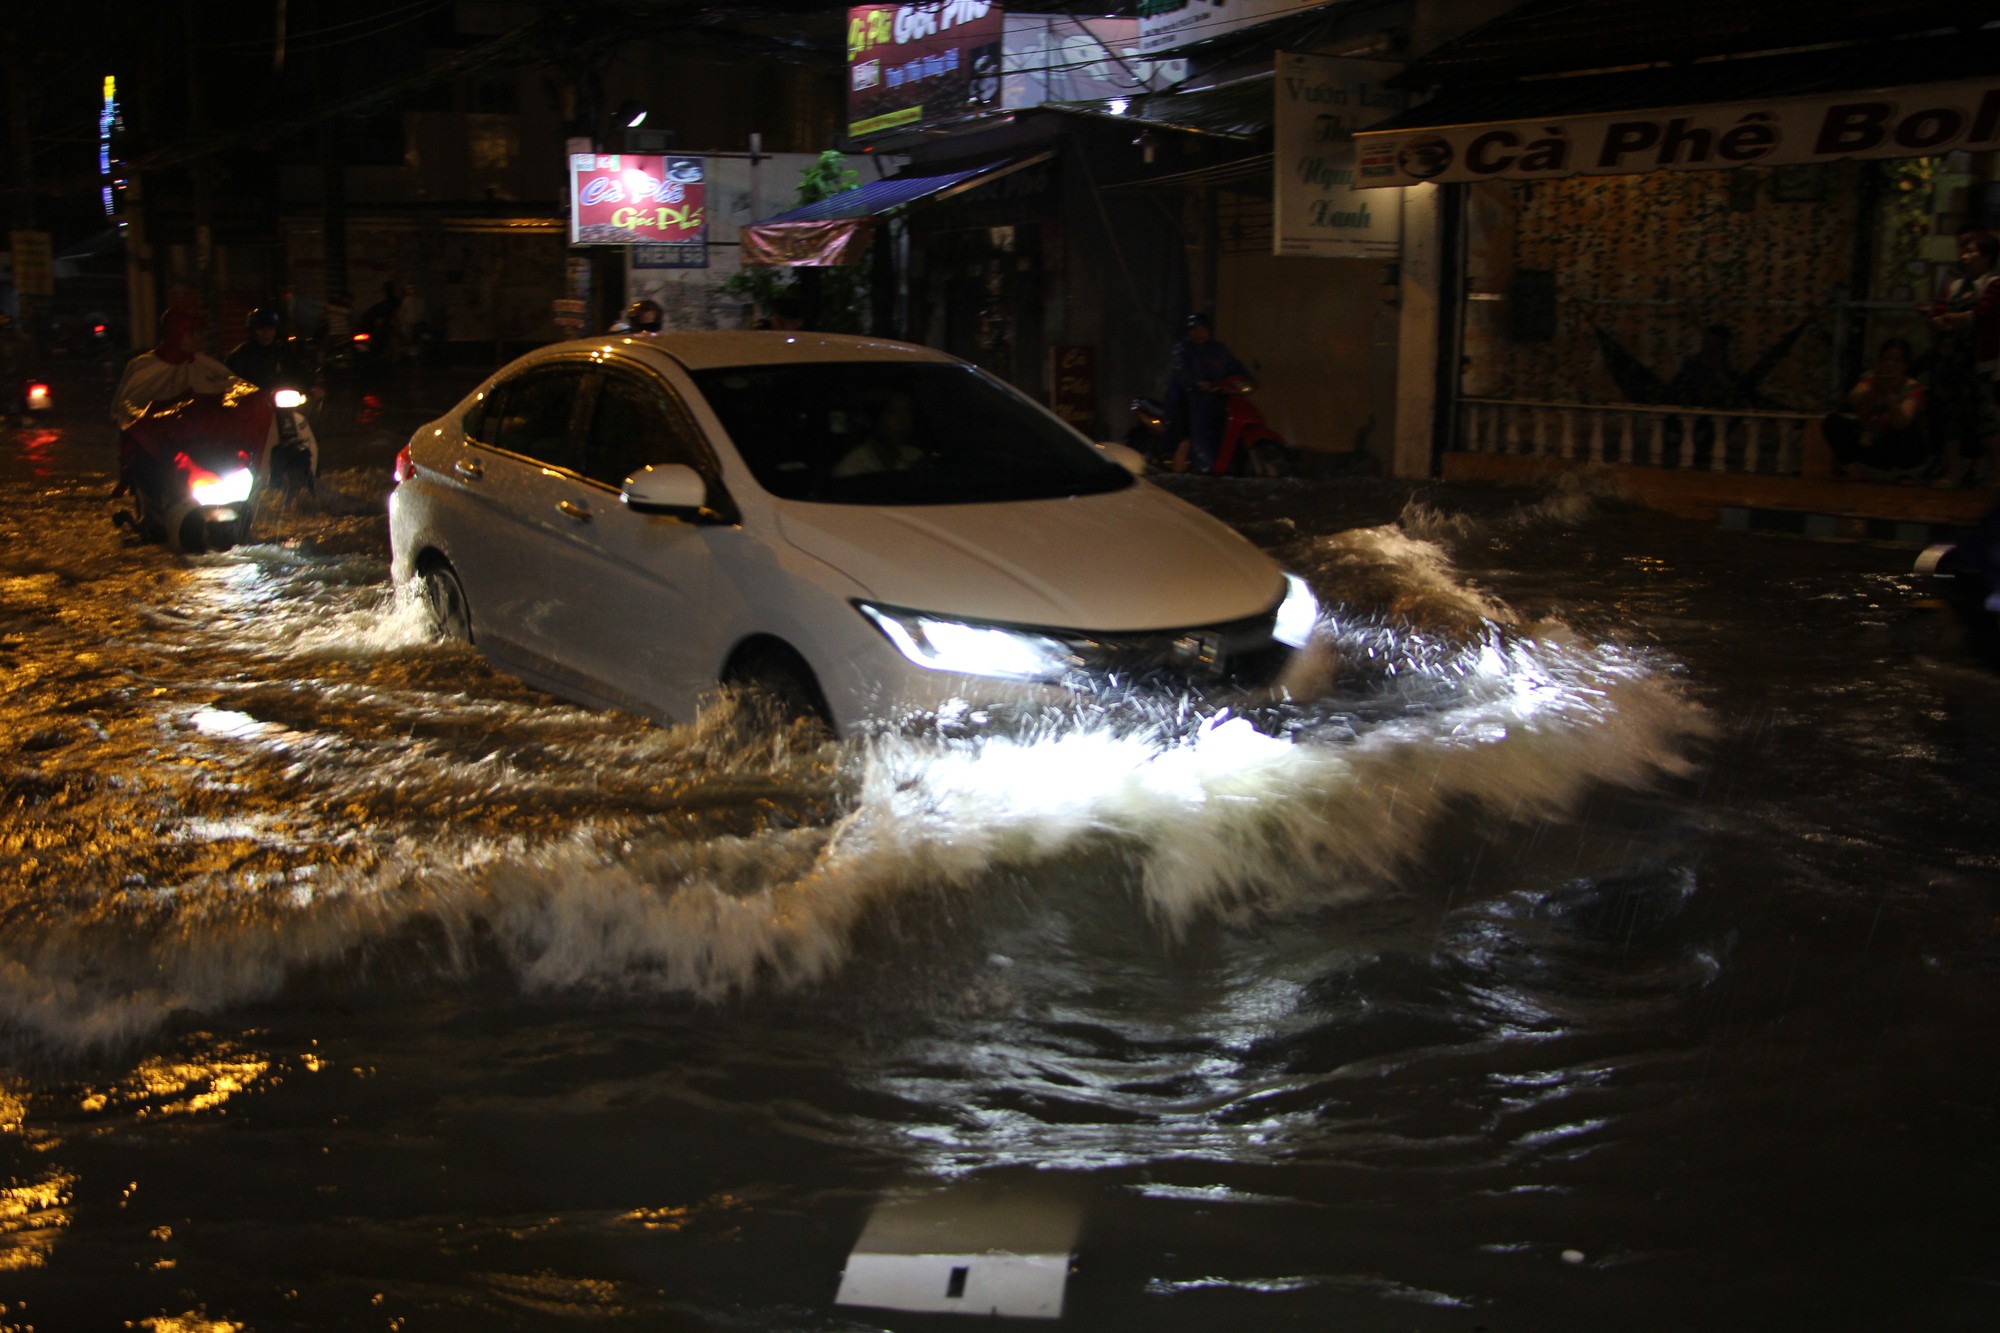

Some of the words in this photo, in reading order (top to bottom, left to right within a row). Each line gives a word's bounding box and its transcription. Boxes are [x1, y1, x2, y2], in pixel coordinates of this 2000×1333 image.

[1465, 126, 1567, 174] Cà
[1597, 113, 1773, 168] Phê
[580, 176, 626, 206] Cà
[611, 206, 656, 231] Góc
[654, 204, 705, 231] Phố
[1309, 200, 1372, 228] Xanh
